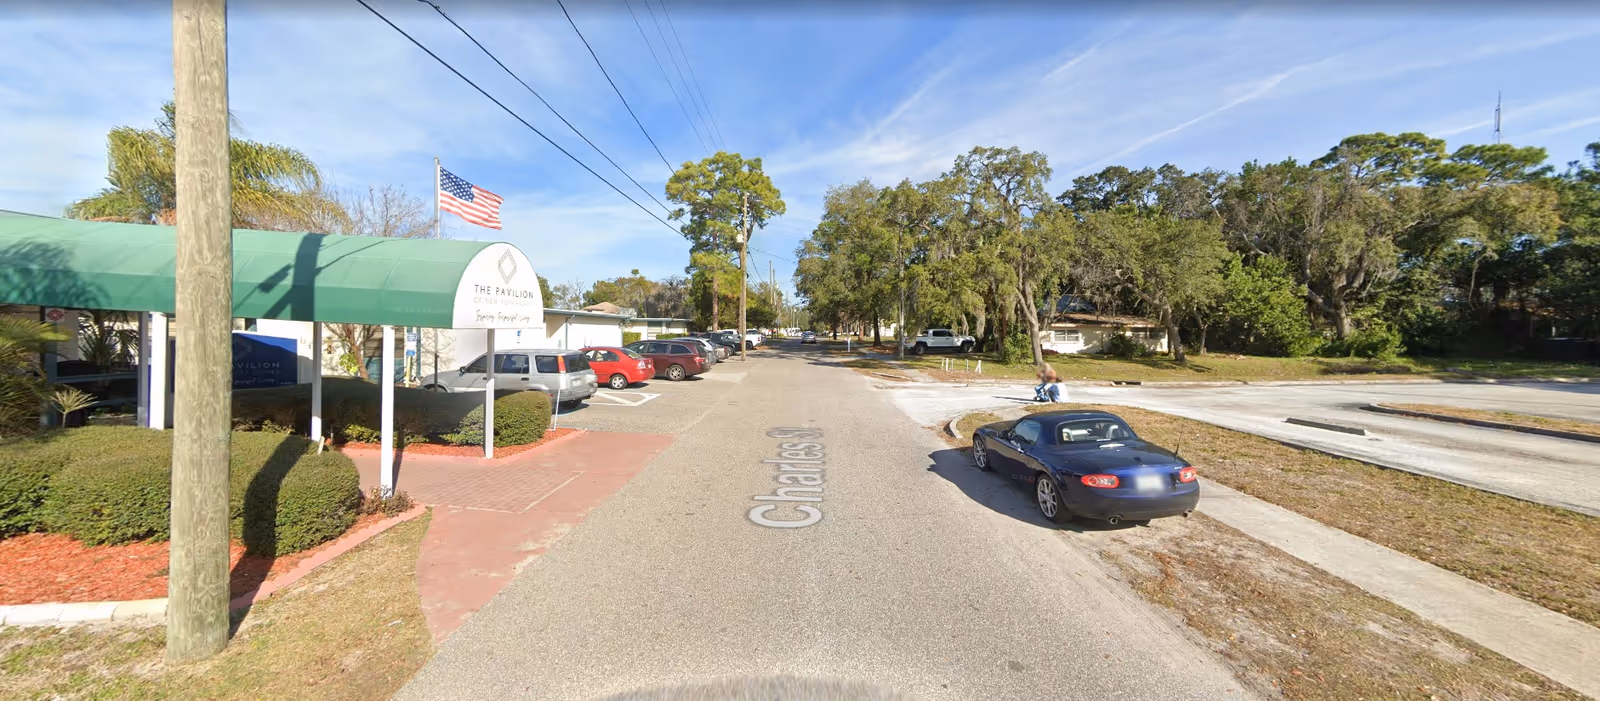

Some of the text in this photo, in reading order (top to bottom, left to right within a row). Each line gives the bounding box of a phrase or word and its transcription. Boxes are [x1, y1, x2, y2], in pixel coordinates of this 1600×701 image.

[474, 284, 534, 299] THE PAVILION
[232, 362, 280, 370] VILION
